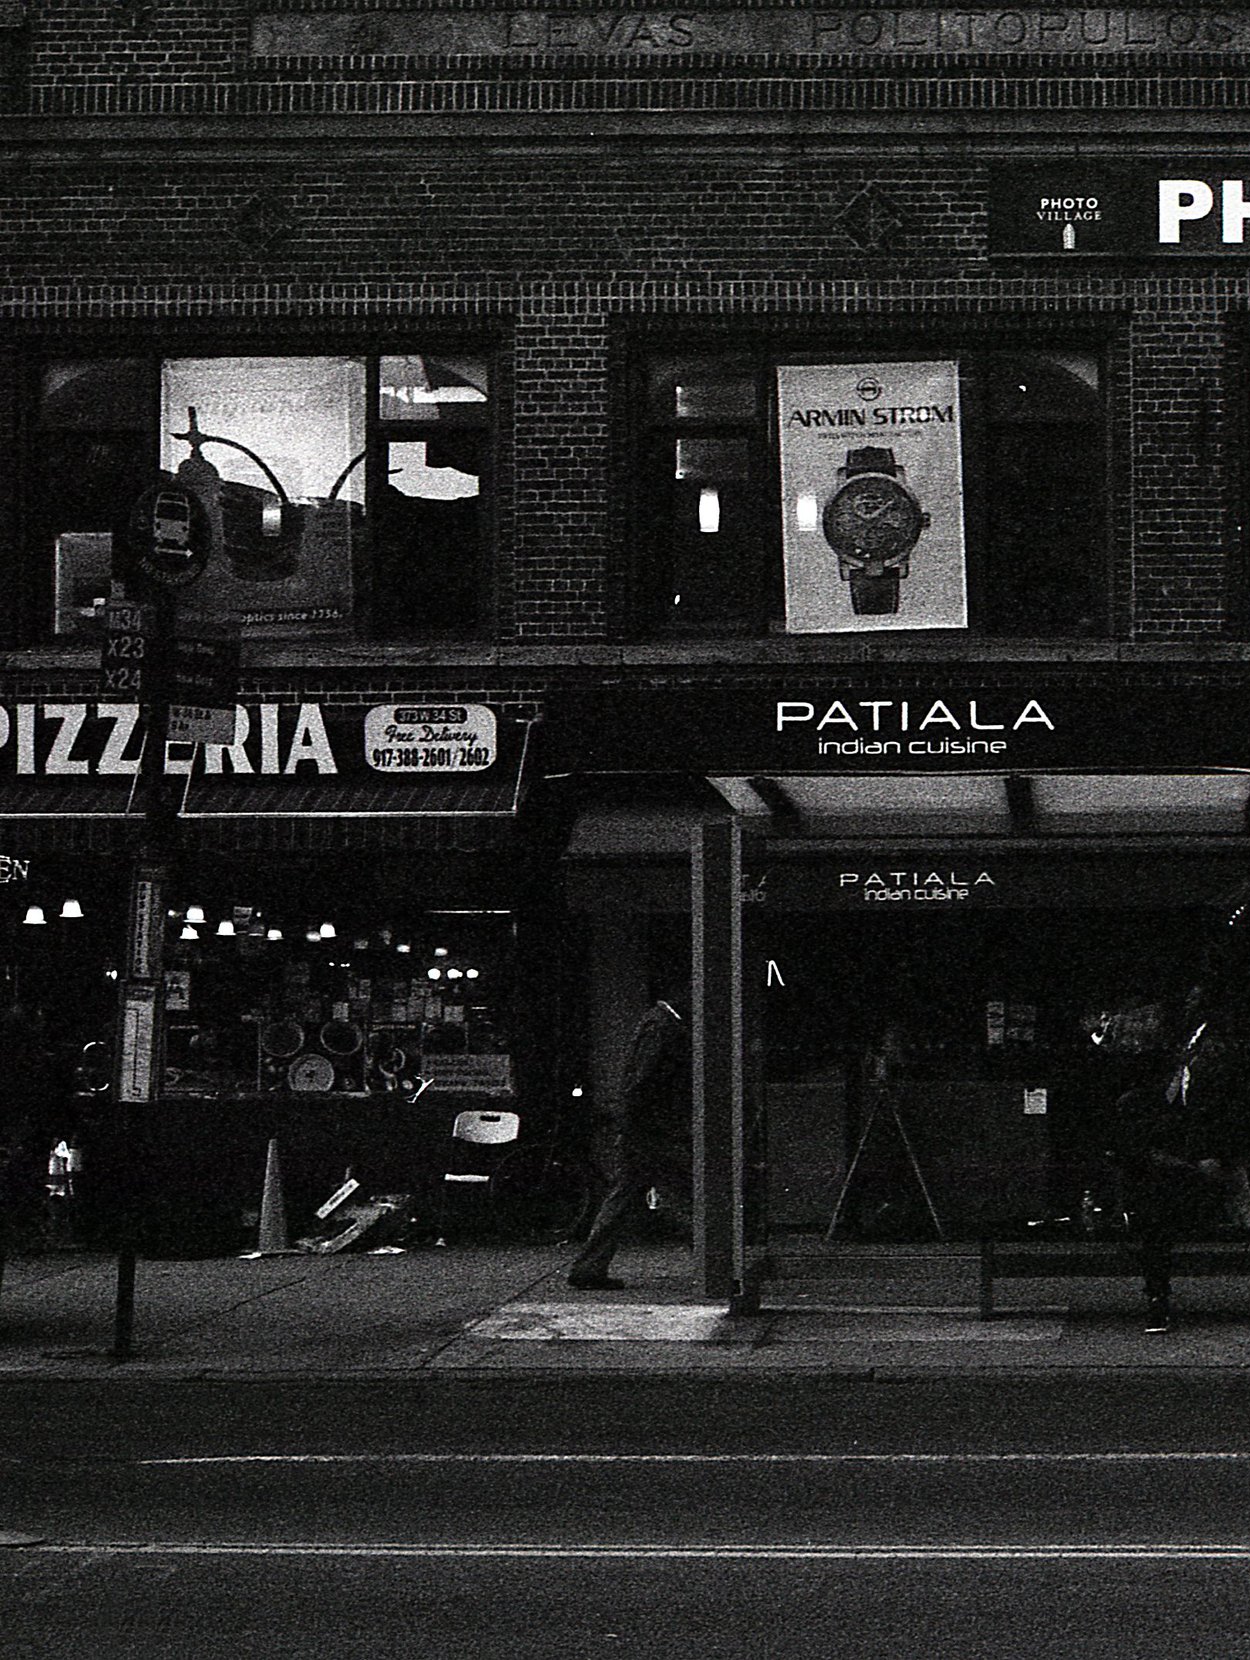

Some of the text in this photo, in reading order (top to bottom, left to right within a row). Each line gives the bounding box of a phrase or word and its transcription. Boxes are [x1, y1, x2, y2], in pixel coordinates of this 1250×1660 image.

[1035, 197, 1103, 221] PHOTO VILLAGE
[787, 404, 954, 428] ARMIN STROM
[107, 636, 145, 659] X23
[105, 667, 142, 690] X24
[776, 700, 1055, 732] PATIALA
[0, 703, 339, 776] IZZRIA
[385, 724, 478, 746] Free Delivery
[818, 735, 1008, 755] indian cuisine
[839, 870, 996, 888] PATIALA
[863, 885, 970, 901] indian cuisine
